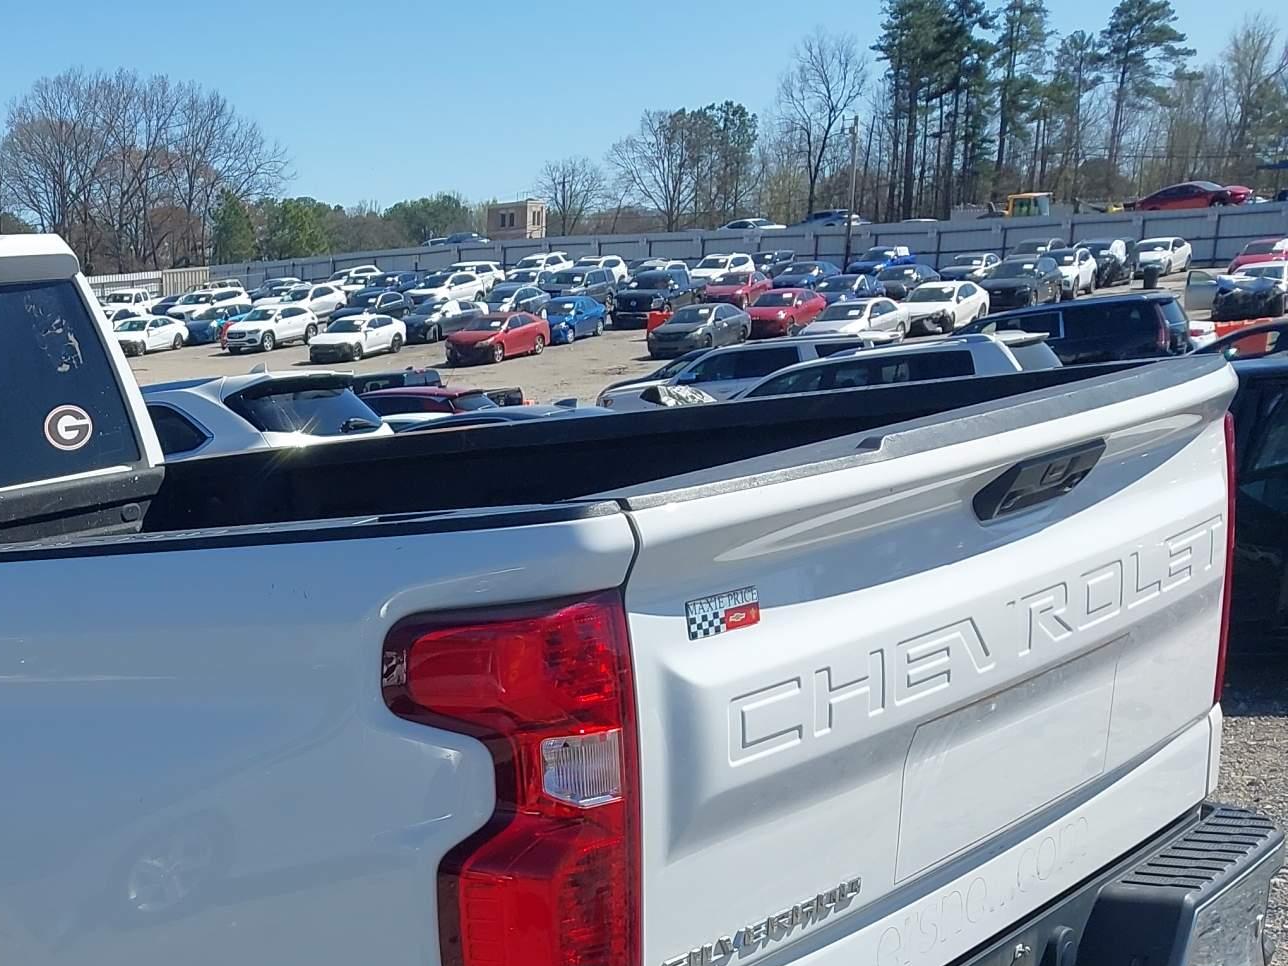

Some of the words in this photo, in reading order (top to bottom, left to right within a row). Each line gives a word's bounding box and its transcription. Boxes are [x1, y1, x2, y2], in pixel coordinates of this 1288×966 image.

[46, 407, 91, 448] G
[687, 595, 726, 617] MAXIE
[726, 588, 759, 608] PRICE
[728, 514, 1223, 767] CHEVROLET
